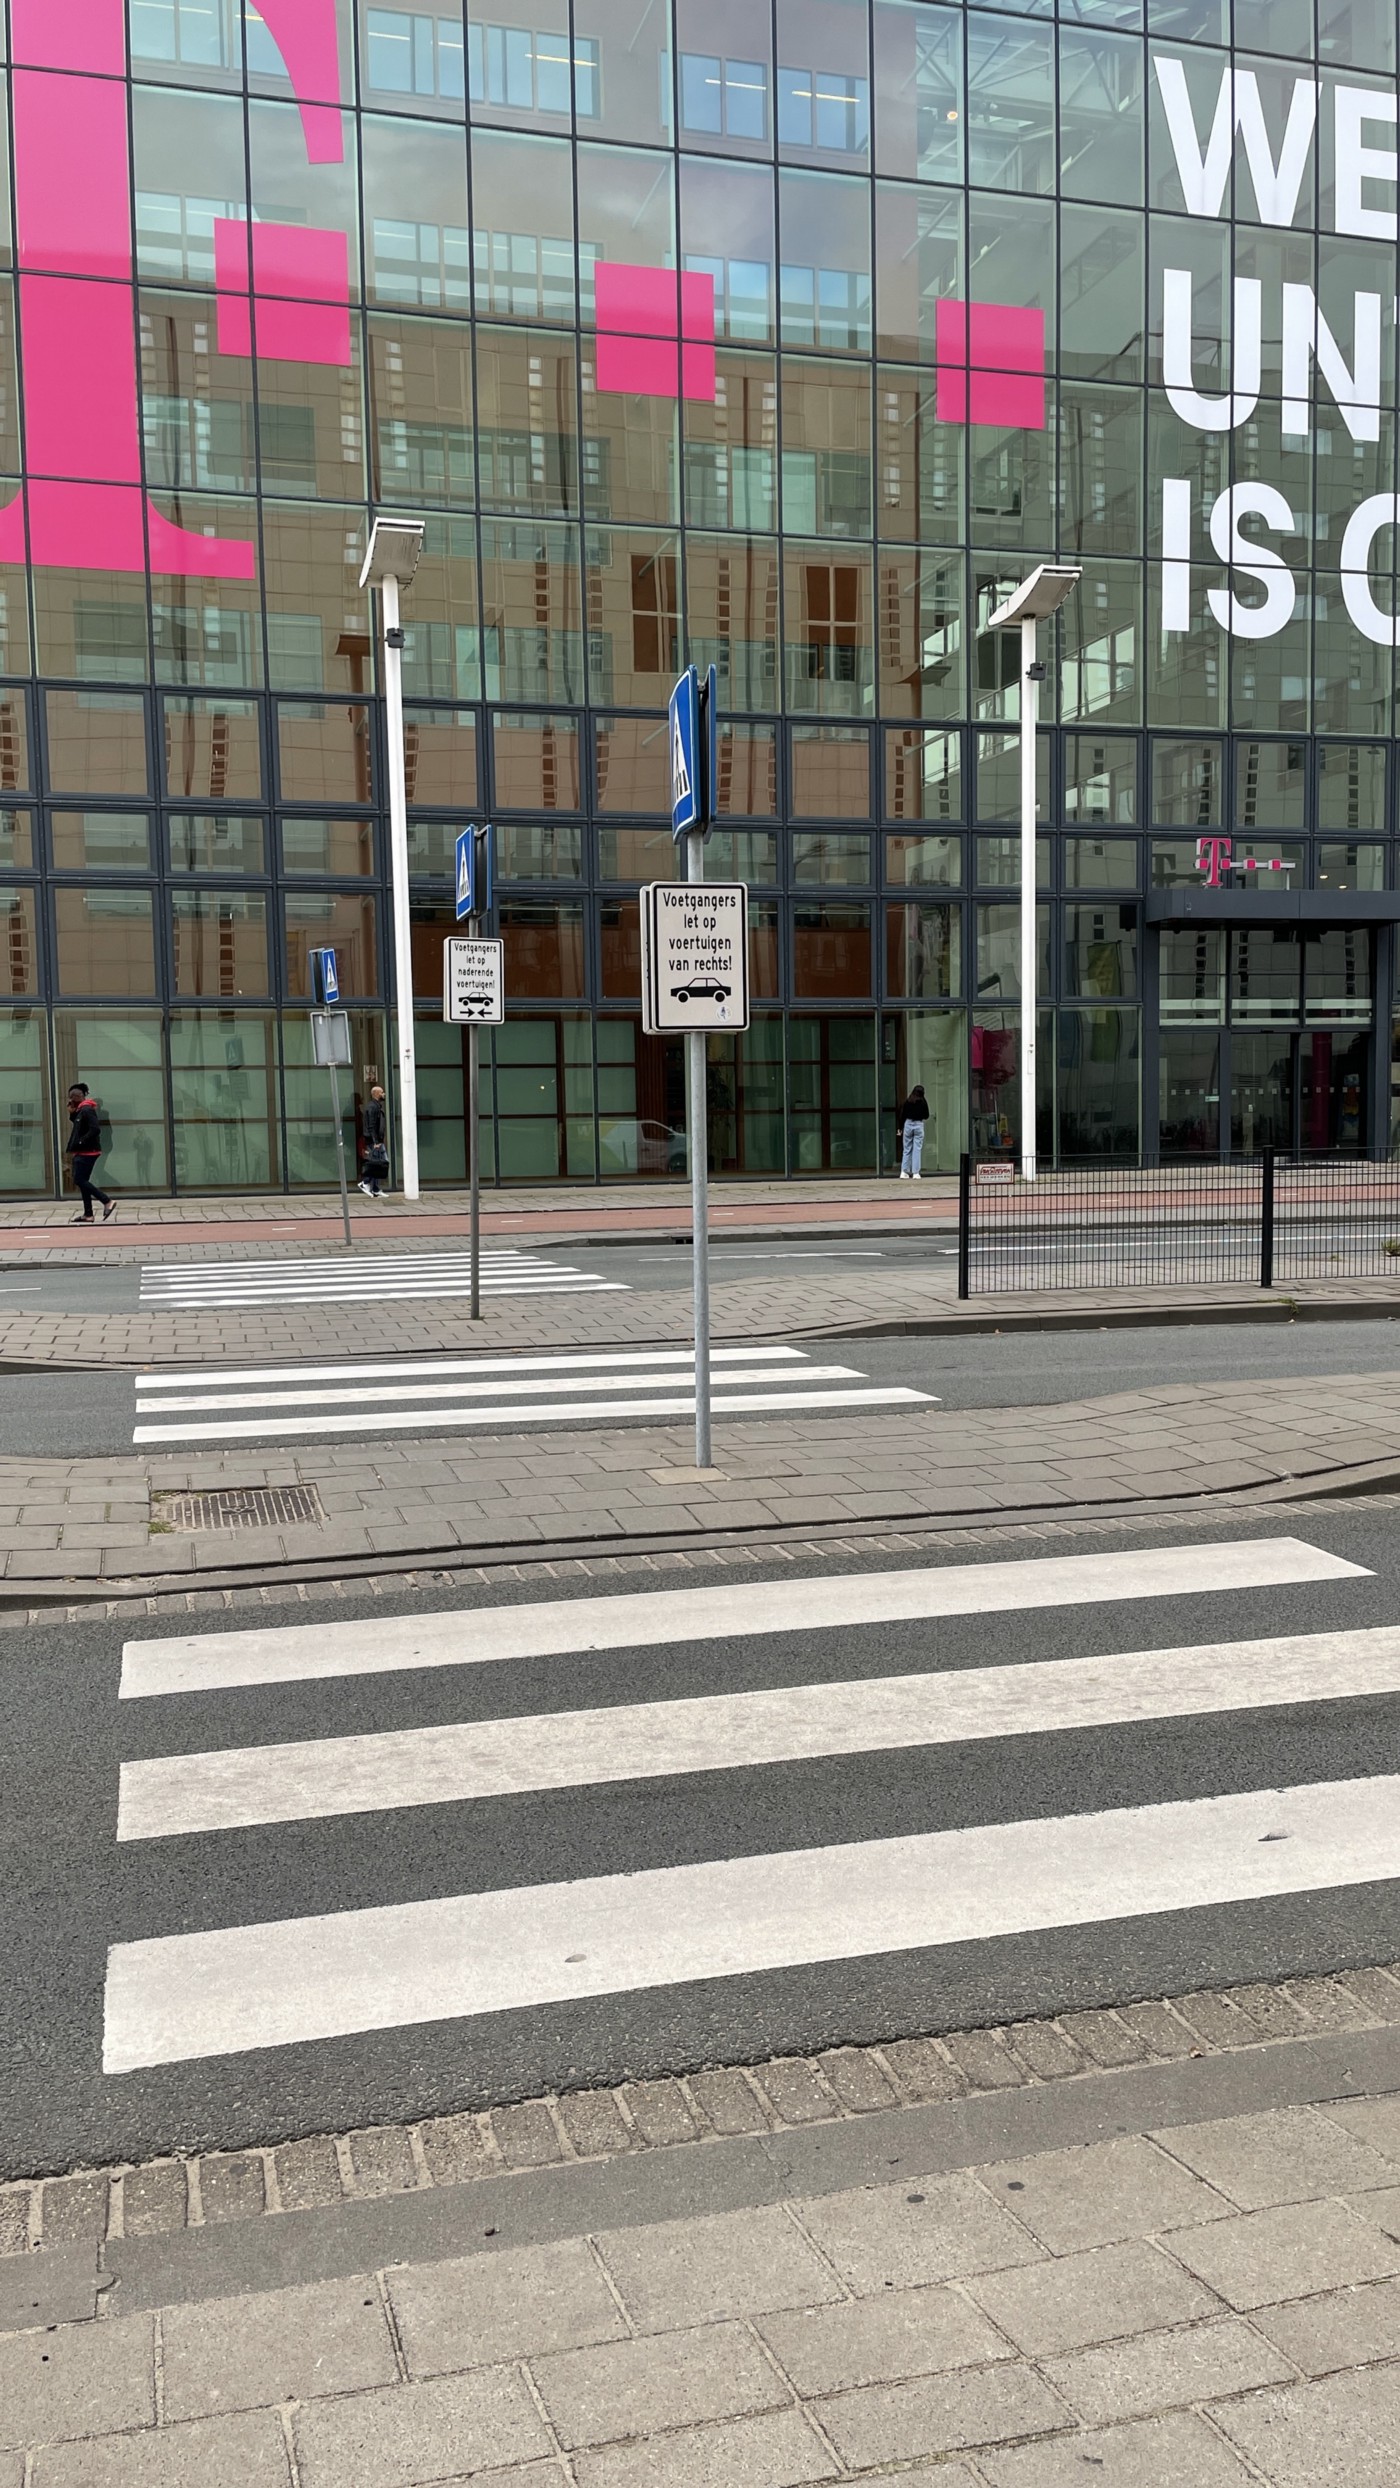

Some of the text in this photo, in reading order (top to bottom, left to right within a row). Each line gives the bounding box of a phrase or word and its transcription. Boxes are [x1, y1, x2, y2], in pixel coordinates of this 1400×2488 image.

[1162, 268, 1400, 442] UN
[1161, 478, 1296, 639] IS
[663, 892, 736, 911] Voetgangers
[684, 914, 717, 931] let op
[454, 943, 497, 955] Voetgangers
[669, 936, 731, 954] voertuigen
[466, 956, 486, 966] let op
[669, 955, 732, 971] van rechts!
[458, 968, 494, 977] naderende
[456, 980, 495, 991] voertuigen!
